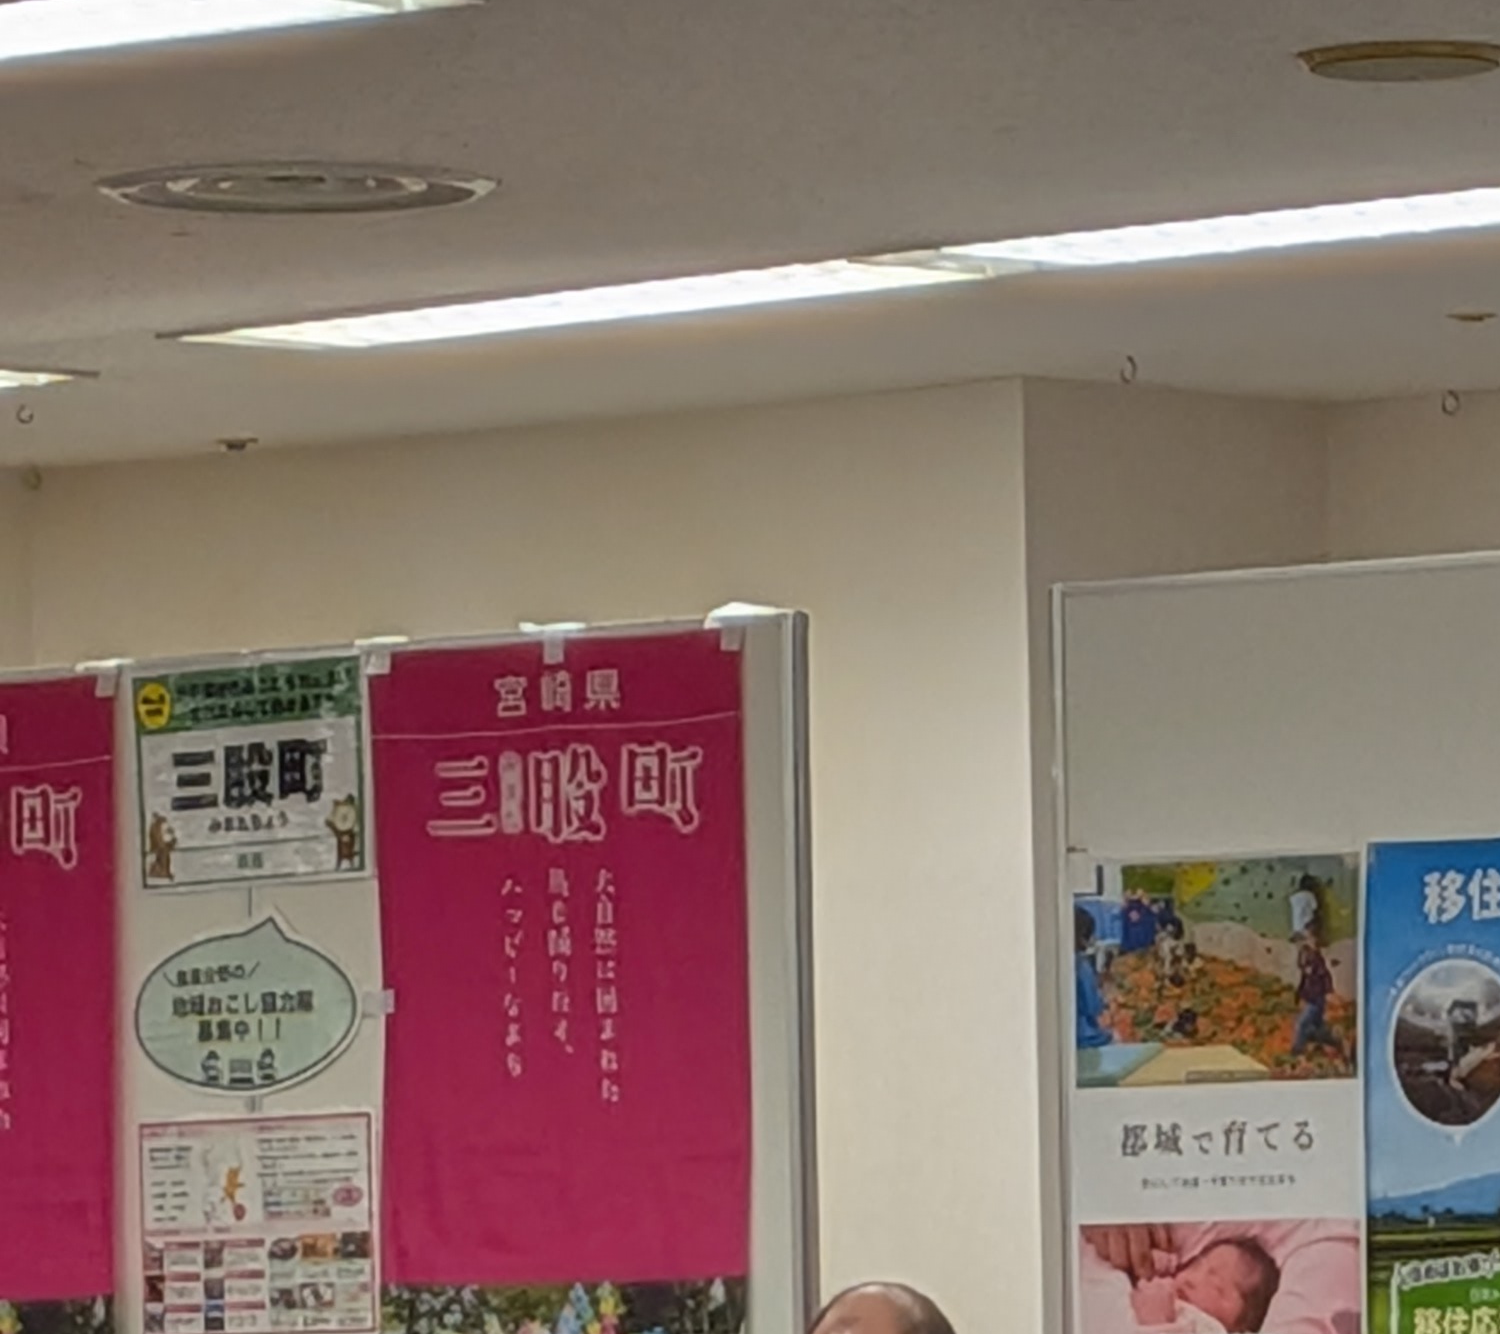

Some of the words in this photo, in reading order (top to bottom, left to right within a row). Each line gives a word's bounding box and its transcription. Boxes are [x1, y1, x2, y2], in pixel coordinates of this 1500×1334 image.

[494, 669, 621, 718] 宮崎県
[170, 737, 328, 810] 三股町
[1120, 1120, 1315, 1157] 都城で育てる
